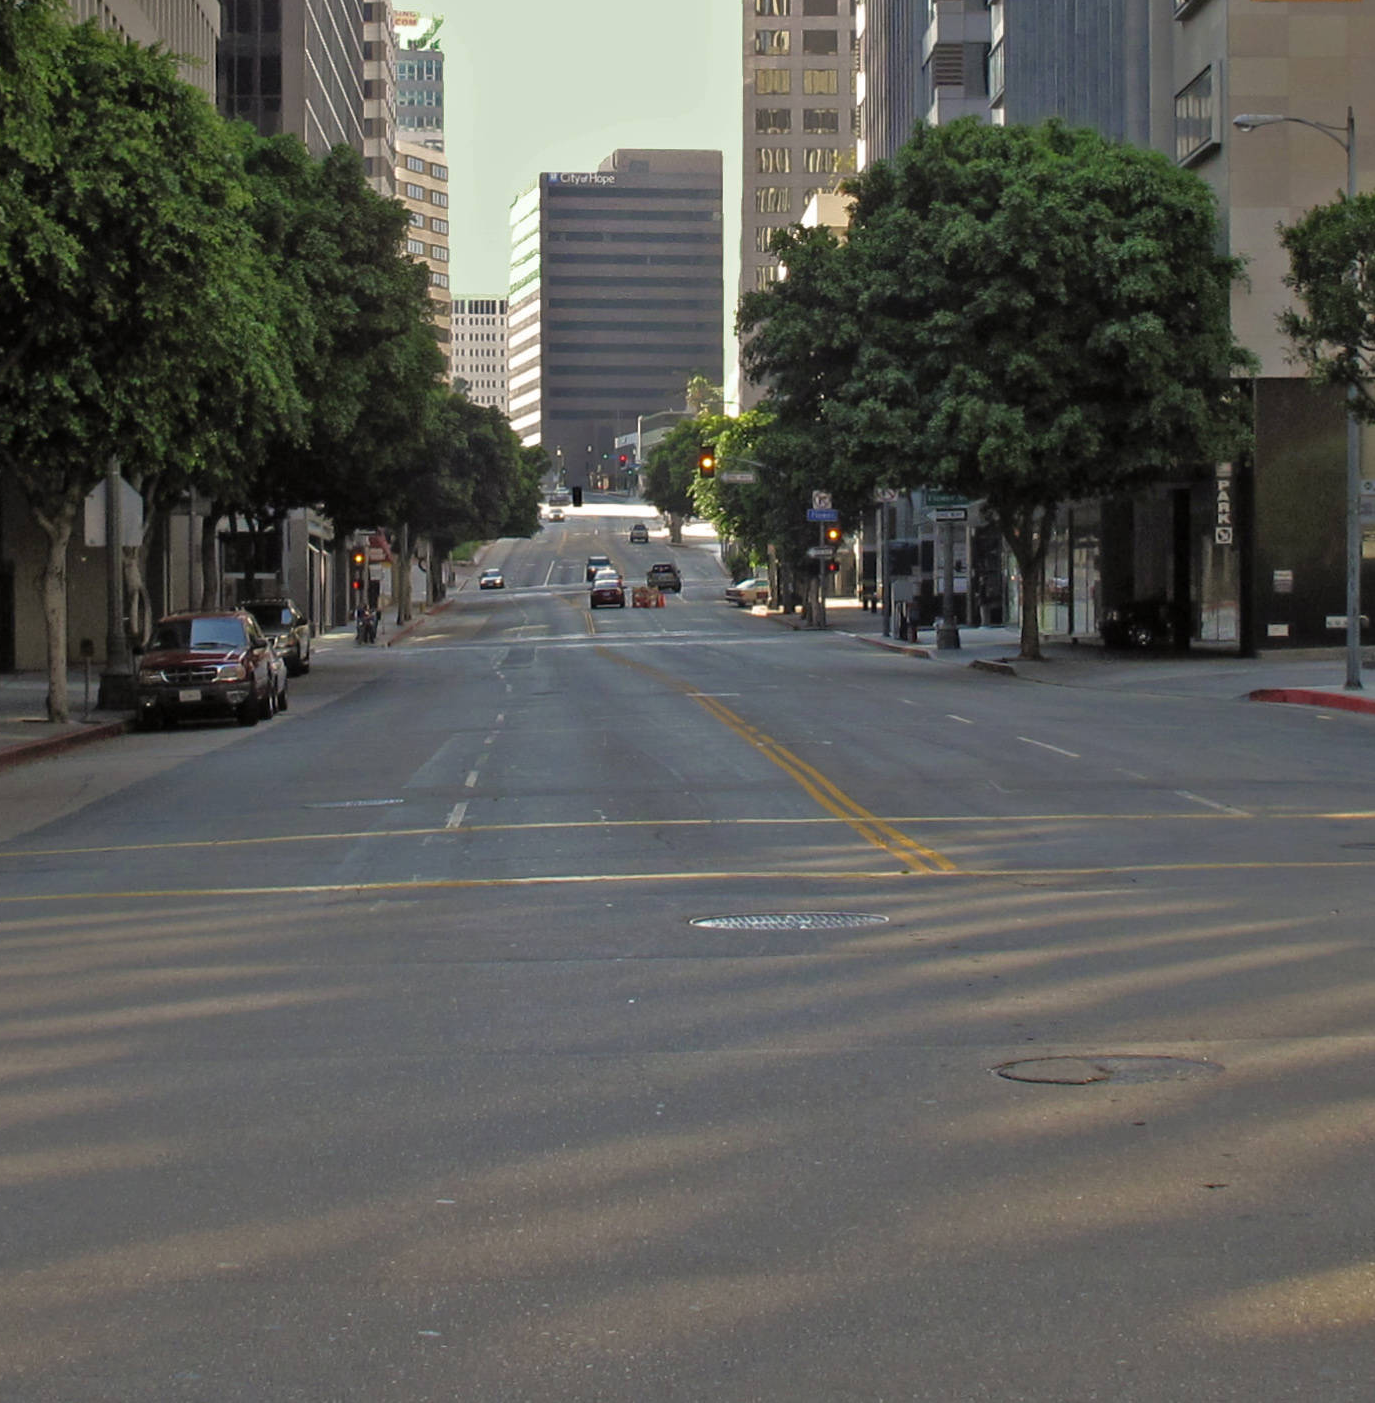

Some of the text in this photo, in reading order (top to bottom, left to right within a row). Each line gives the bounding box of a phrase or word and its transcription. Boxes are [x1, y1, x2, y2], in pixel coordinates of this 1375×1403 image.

[560, 172, 581, 185] City
[589, 172, 615, 185] Hope
[1216, 479, 1231, 525] PARK
